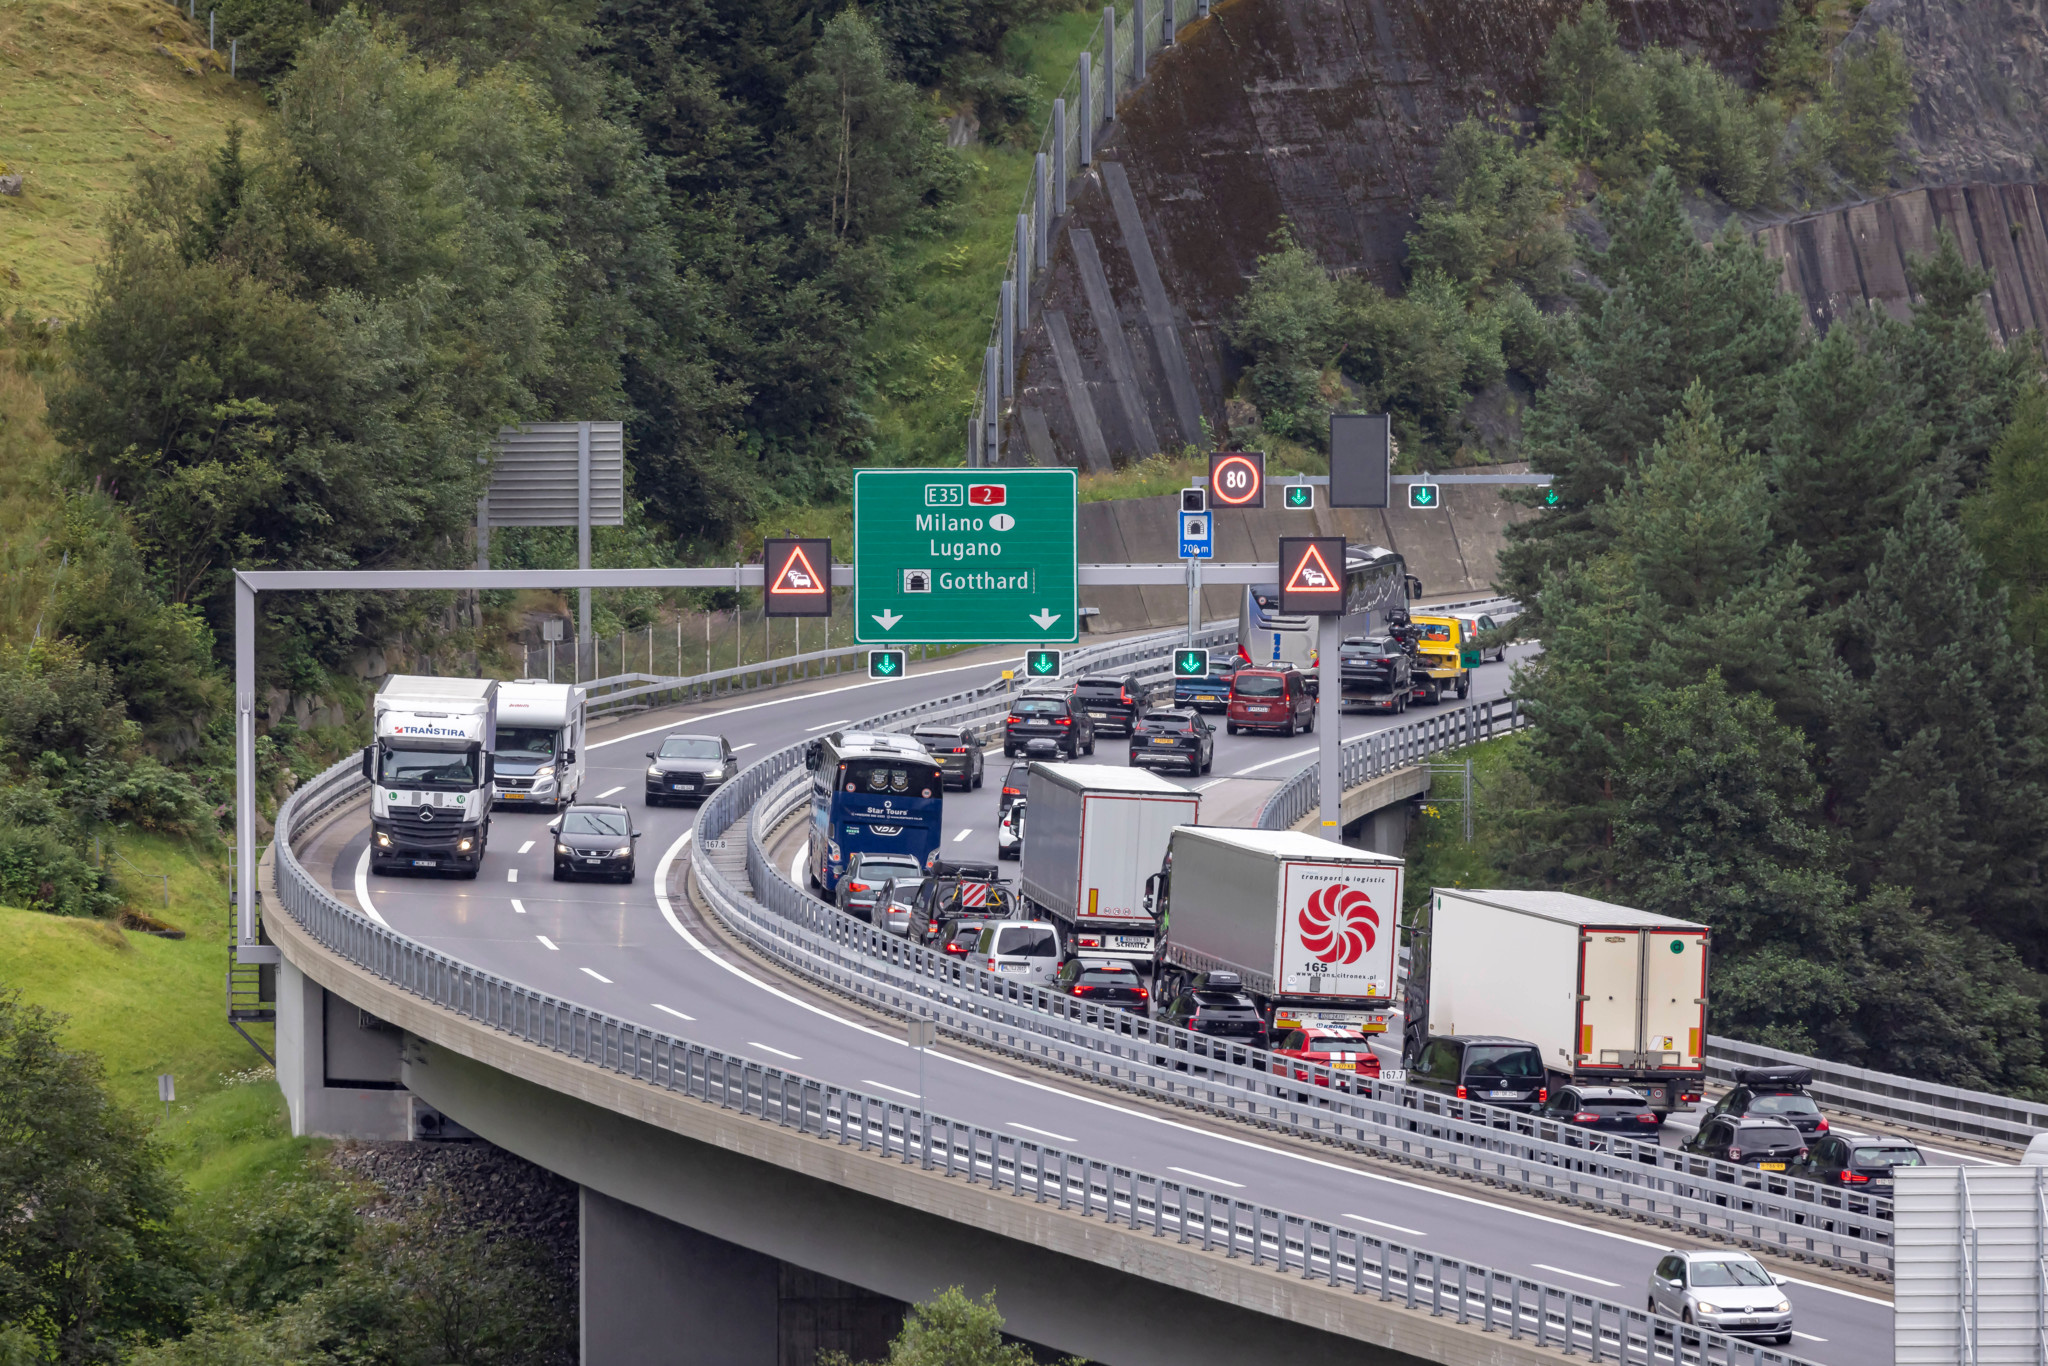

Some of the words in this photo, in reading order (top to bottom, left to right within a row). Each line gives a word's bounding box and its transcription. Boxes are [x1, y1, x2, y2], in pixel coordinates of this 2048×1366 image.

[1226, 471, 1247, 488] 80
[929, 488, 958, 502] E35
[983, 488, 992, 502] 2
[915, 513, 984, 531] Milano
[930, 539, 1002, 560] Lugano
[939, 571, 1028, 589] Gotthard
[404, 726, 466, 737] TRANSTIRA
[867, 806, 884, 814] Star
[886, 808, 907, 816] Tours
[874, 825, 897, 833] VDL
[706, 840, 726, 849] 167.8
[1301, 873, 1342, 882] transport
[1353, 875, 1386, 884] logistic
[1116, 941, 1149, 949] SCHMITZ
[1304, 962, 1328, 972] 165
[1381, 1070, 1404, 1080] 167.7
